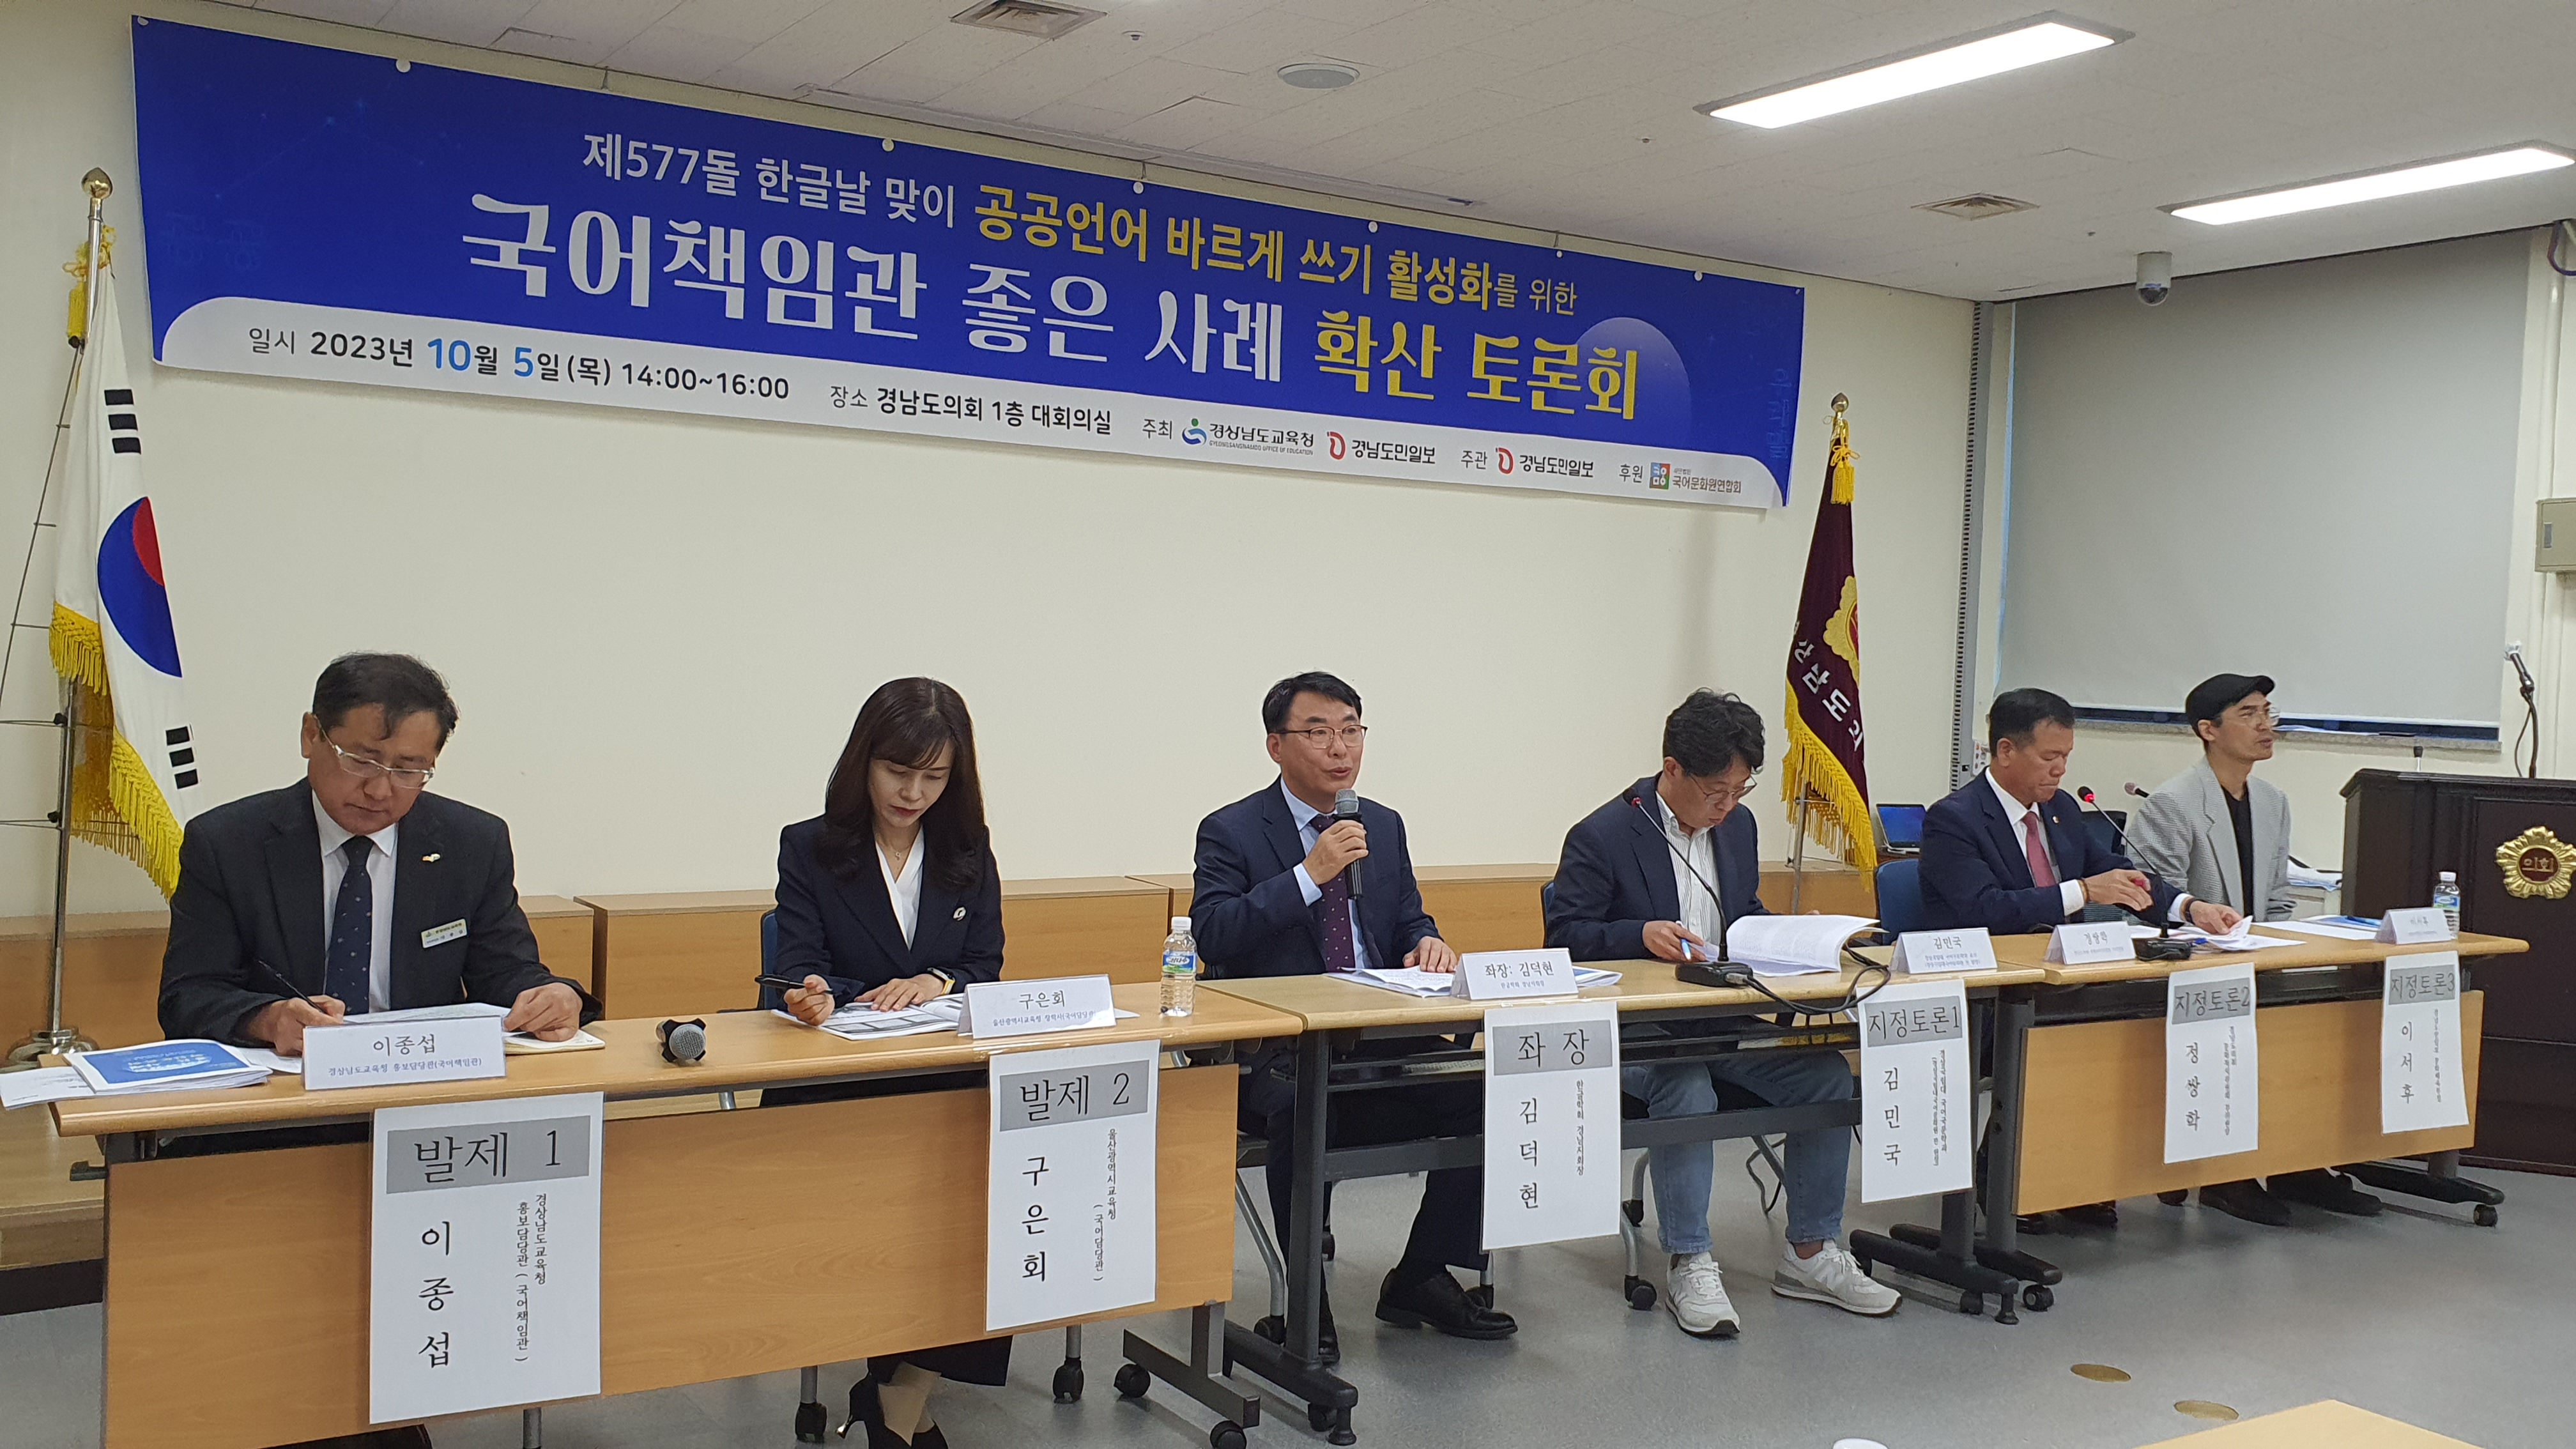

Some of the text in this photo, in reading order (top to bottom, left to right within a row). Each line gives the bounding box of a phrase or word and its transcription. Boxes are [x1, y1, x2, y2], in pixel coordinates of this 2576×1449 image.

[583, 133, 1577, 316] 제577돌 한글날 맞이 공공언어 바르게 쓰기 활성화를 위한
[463, 194, 1637, 420] 국어책임관 좋은 사례 확산 토론회
[248, 327, 296, 355] 일시
[310, 332, 414, 369] 2023년
[427, 338, 500, 376] 10월
[622, 362, 790, 400] 14:00~16:00
[830, 385, 1112, 435] 장소 경남도의회 1층 대회의실
[1142, 418, 1315, 448] 주최 경상남도교육청
[1351, 440, 1436, 465] 경남도민일보
[1460, 449, 1594, 479] 주관 경남도민일보
[1619, 463, 1742, 494] 후원 국어문화원연합회
[1933, 936, 1961, 949] 김민국
[1485, 961, 1554, 979] 좌장: 김덕현
[2391, 972, 2455, 999] 지정토론3
[1019, 990, 1065, 1010] 구은회
[2175, 986, 2250, 1017] 지정토론2
[1869, 1006, 1960, 1039] 지정토론1
[373, 1033, 436, 1057] 이종섭
[1020, 1072, 1130, 1122] 발제 2
[414, 1130, 561, 1183] 발제 1
[534, 1193, 548, 1285] 경상남도교육청
